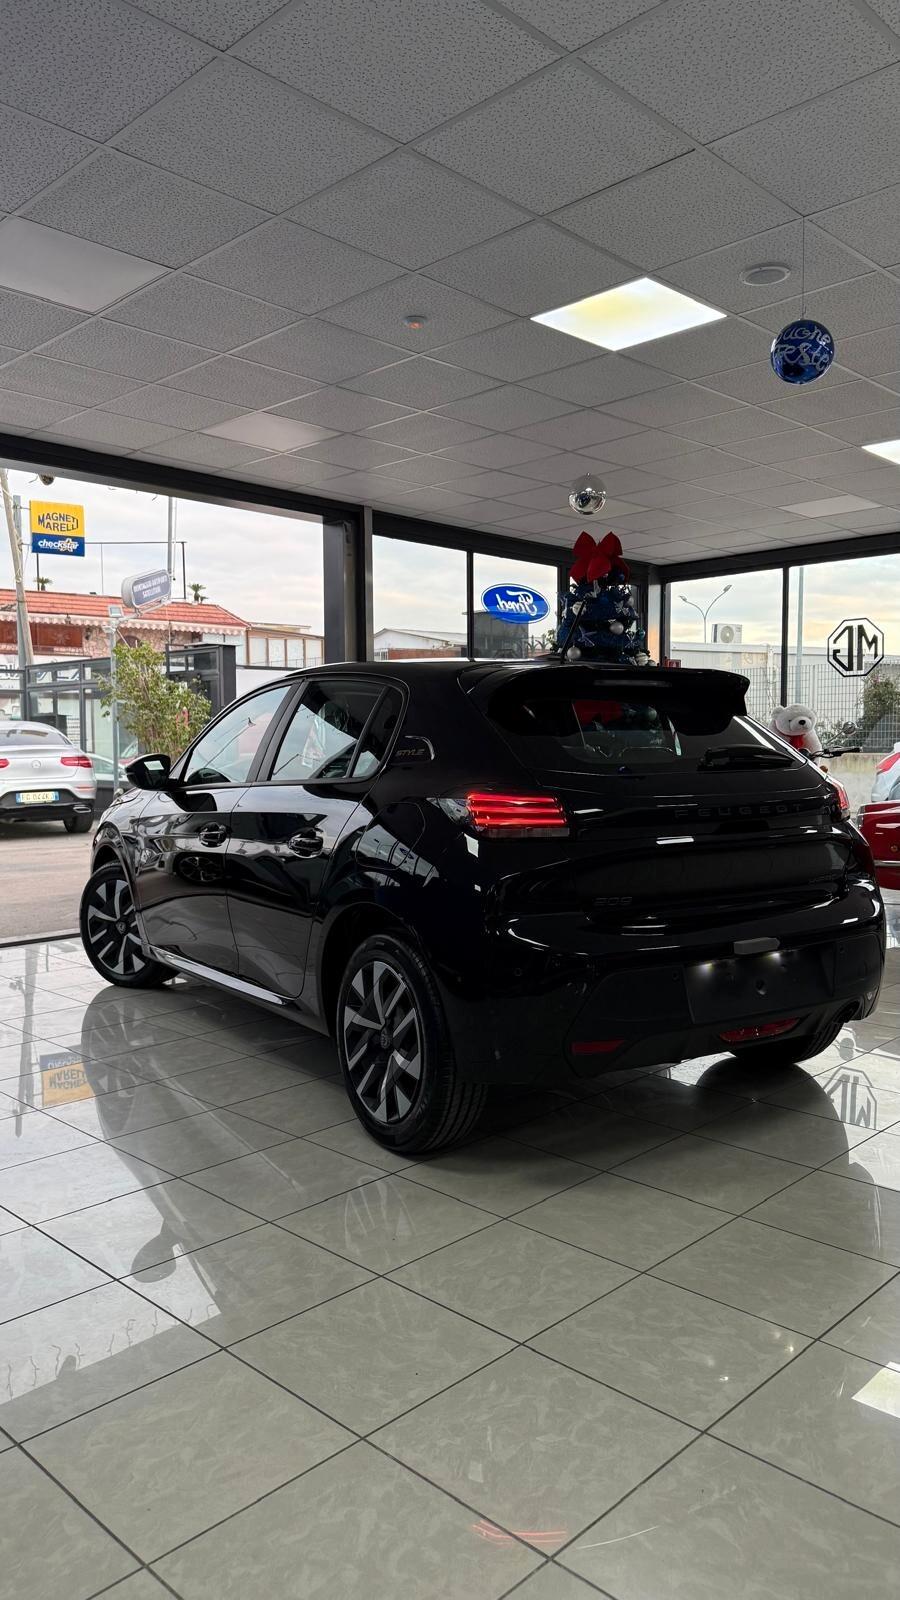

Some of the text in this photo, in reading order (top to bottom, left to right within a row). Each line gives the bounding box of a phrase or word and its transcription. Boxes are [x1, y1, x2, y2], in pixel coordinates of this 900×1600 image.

[38, 538, 79, 551] checkstar
[395, 748, 425, 757] STYLE
[674, 803, 804, 819] PEUGEOT
